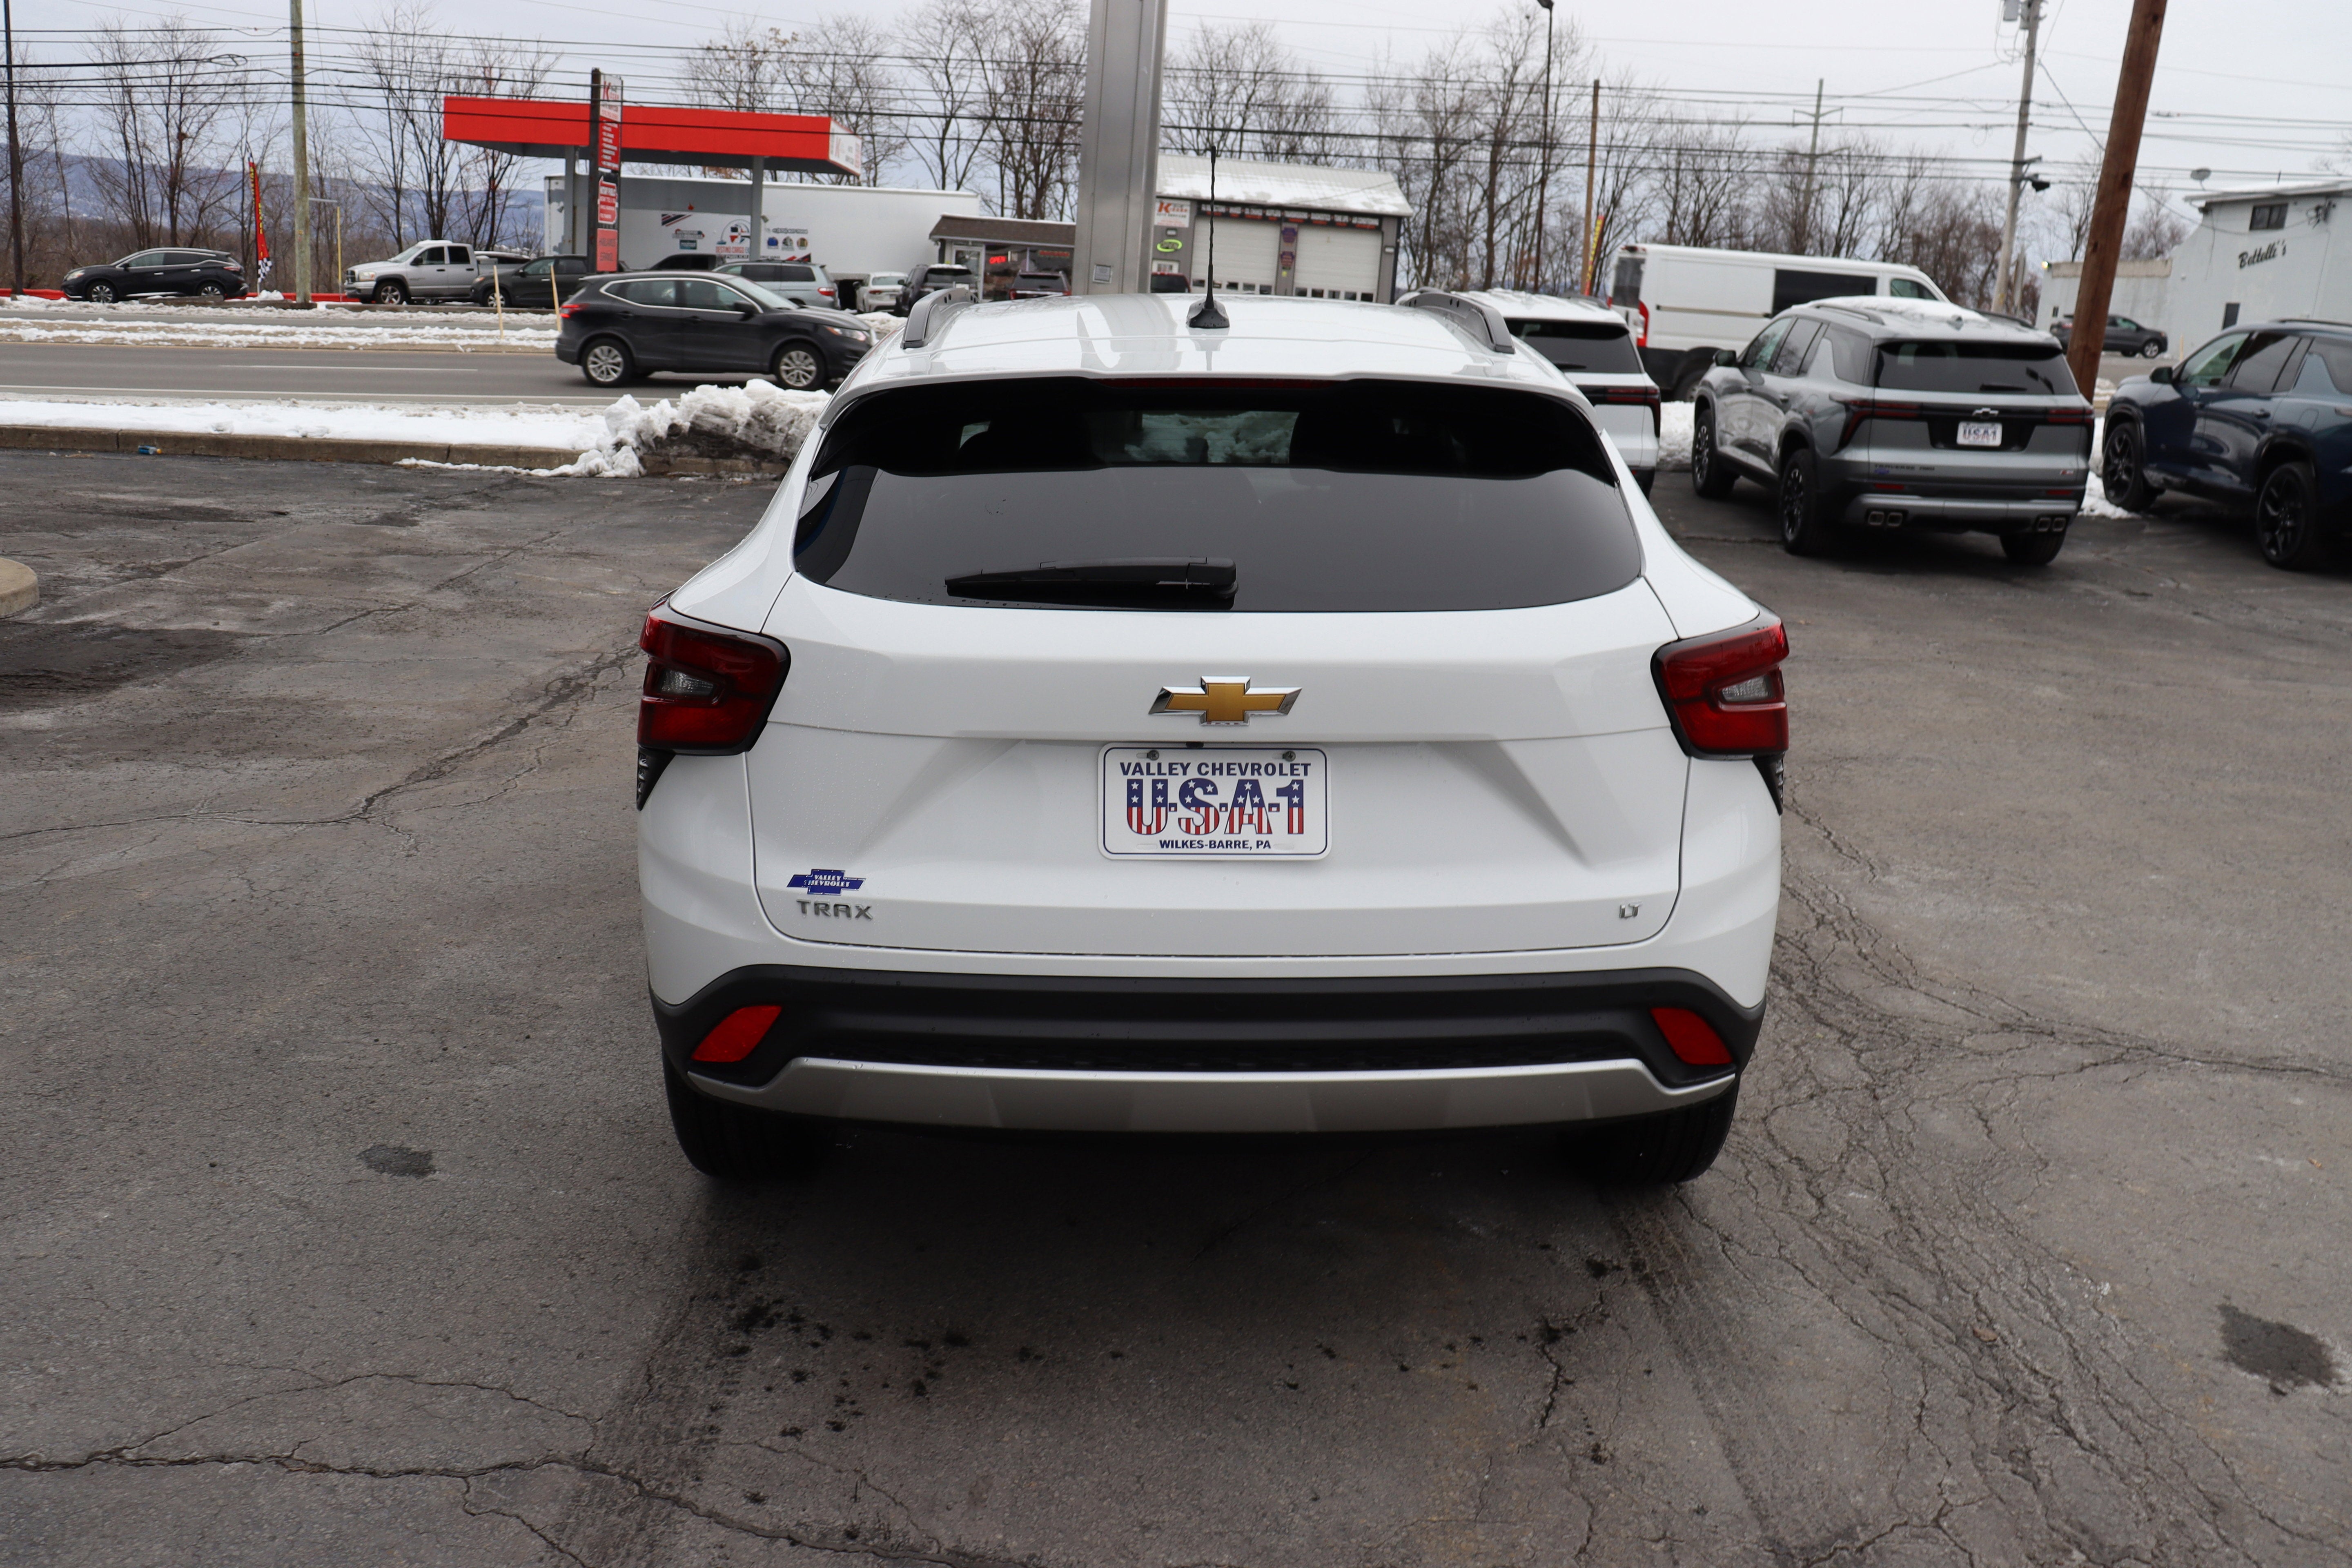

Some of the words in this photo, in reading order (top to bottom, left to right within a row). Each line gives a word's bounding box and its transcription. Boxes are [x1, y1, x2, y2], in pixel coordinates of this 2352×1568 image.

[989, 256, 1007, 265] OPEN
[1120, 762, 1191, 776] VALLEY
[1197, 763, 1311, 777] CHEVROLET
[1159, 840, 1252, 851] WILKES-BARRE,
[1256, 840, 1271, 849] PA
[796, 899, 873, 920] TRAX
[1619, 901, 1642, 919] LT
